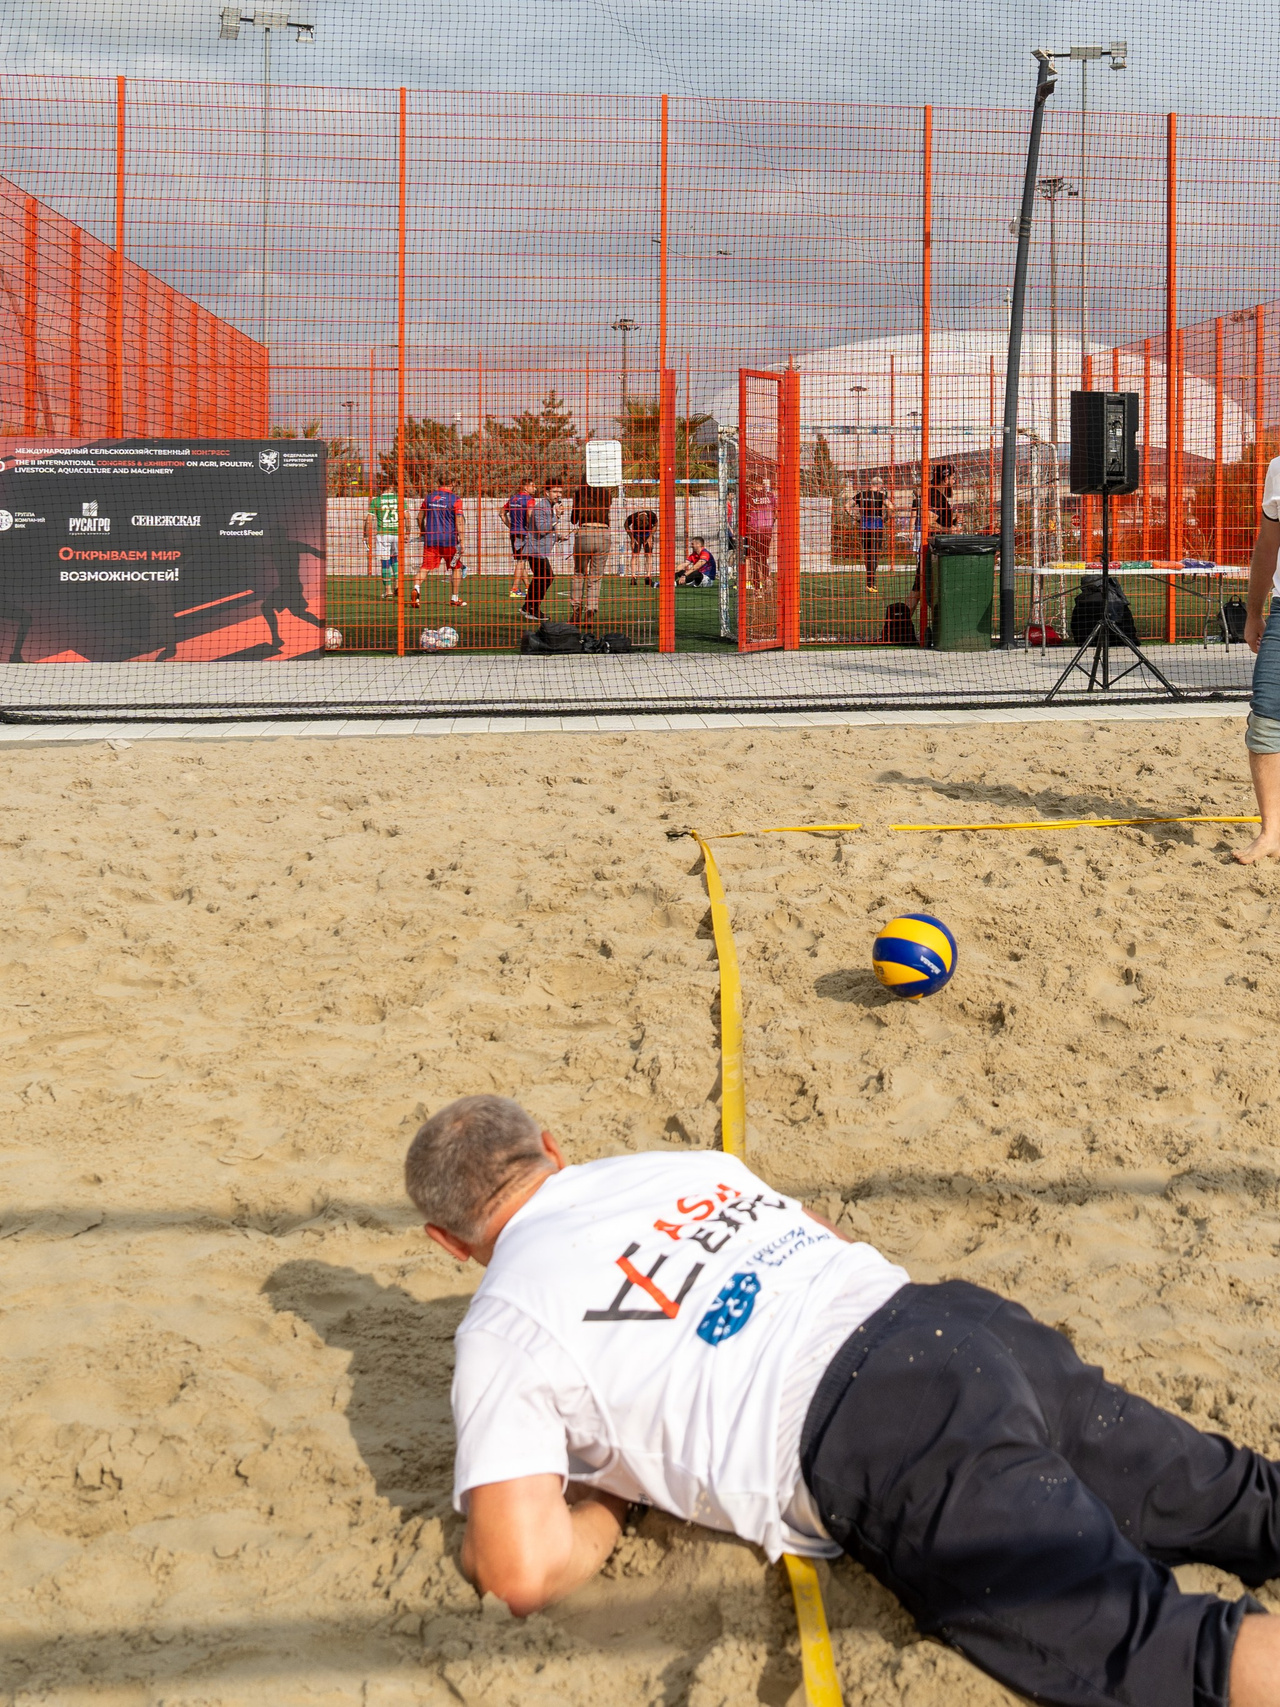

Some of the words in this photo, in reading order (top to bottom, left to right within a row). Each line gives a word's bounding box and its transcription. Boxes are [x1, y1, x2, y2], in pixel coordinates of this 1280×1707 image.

[69, 517, 111, 532] РУСАГРО
[131, 515, 201, 527] СЕНЕЖСКАЯ
[60, 567, 179, 581] ВОЗМОЖНОСТЕЙ!
